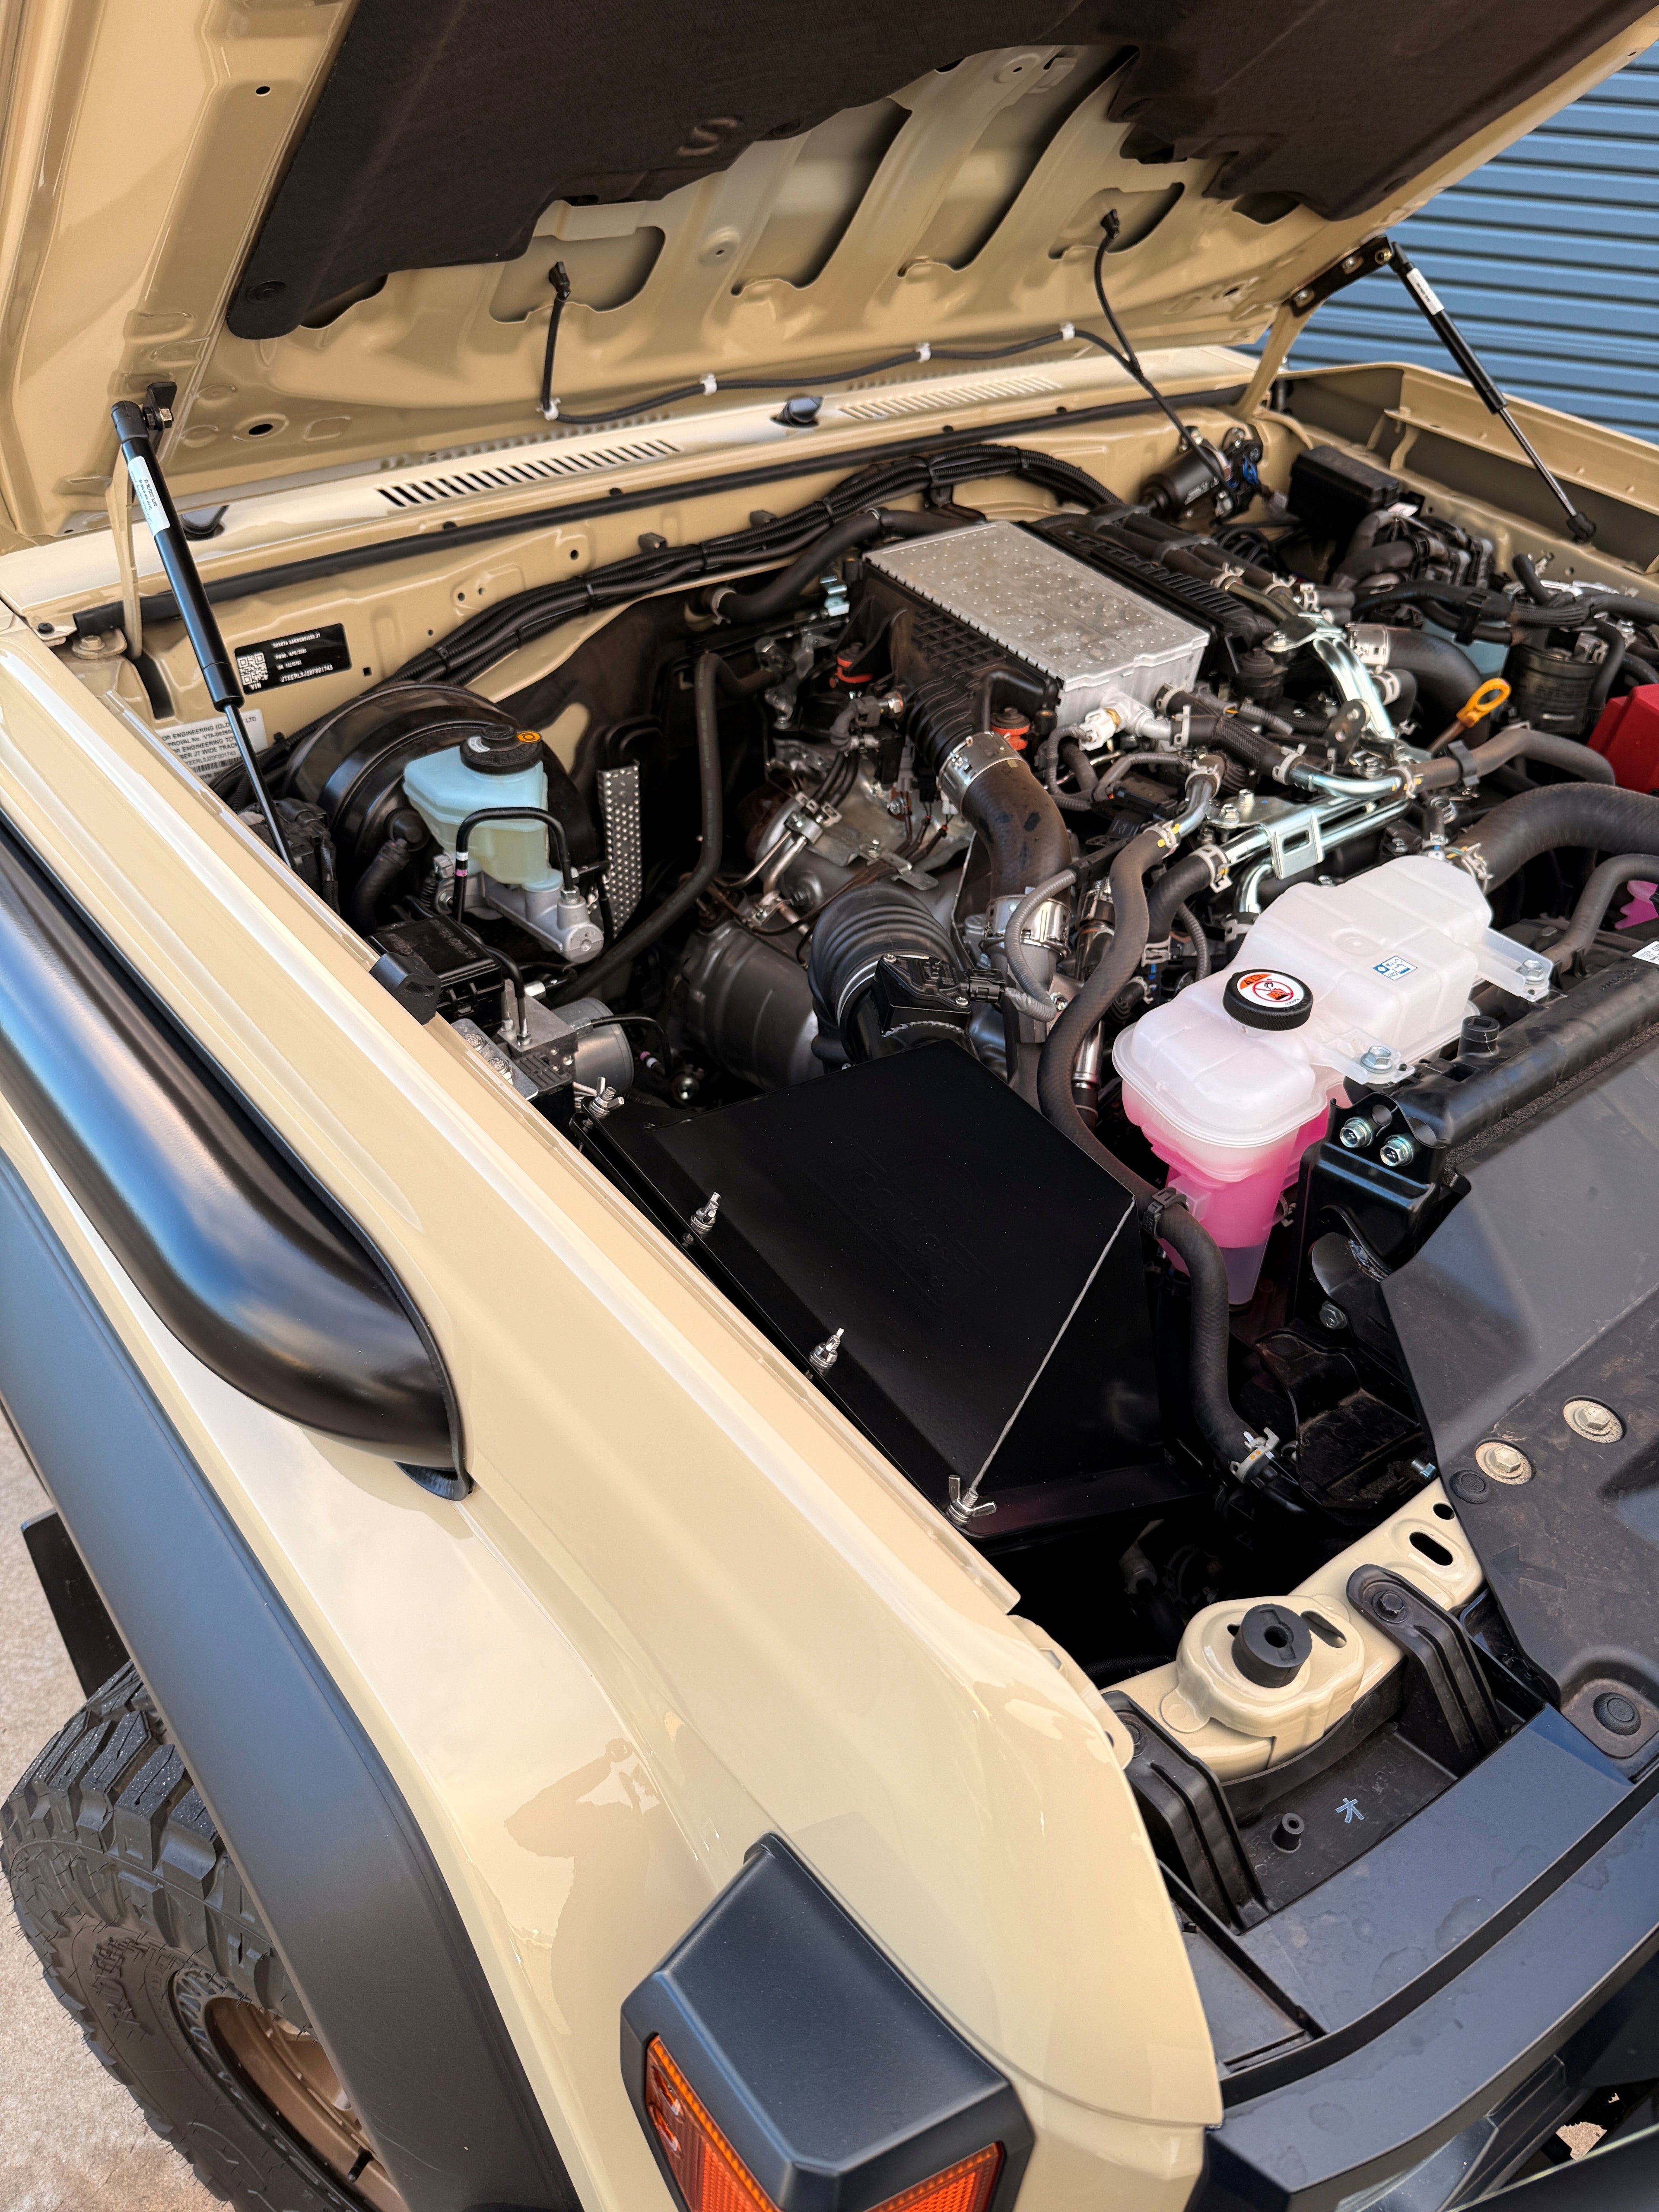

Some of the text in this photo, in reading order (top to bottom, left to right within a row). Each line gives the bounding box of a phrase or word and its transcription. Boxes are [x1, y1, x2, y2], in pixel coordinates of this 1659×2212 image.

[249, 681, 261, 690] VIN
[173, 725, 214, 739] ENGINEERING
[182, 738, 223, 753] ENGINEERING
